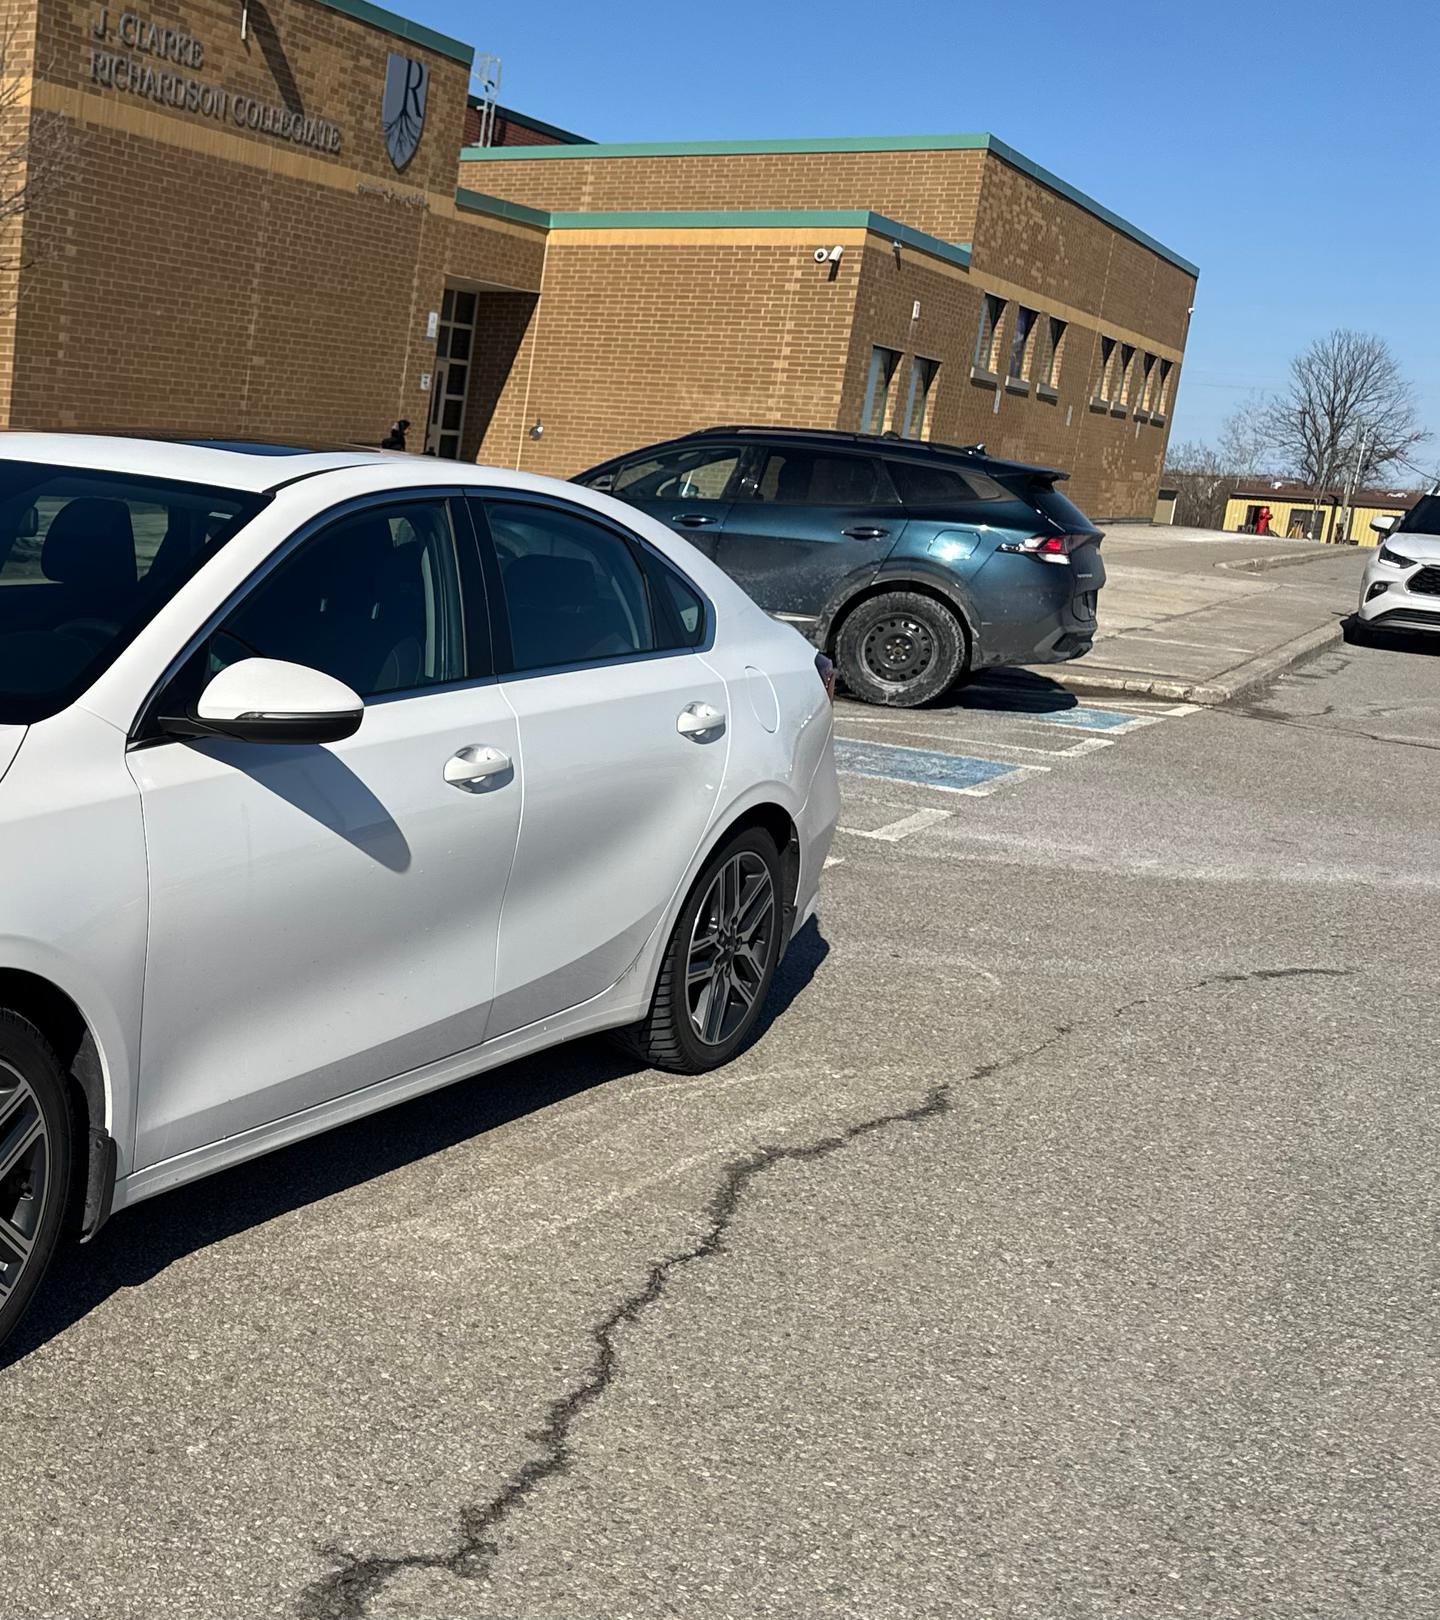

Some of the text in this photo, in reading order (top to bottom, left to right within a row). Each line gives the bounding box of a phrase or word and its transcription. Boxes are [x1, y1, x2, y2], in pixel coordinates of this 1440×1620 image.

[92, 7, 204, 70] J. CLARKE
[90, 48, 341, 155] RICHARDSON COLLEGIATE
